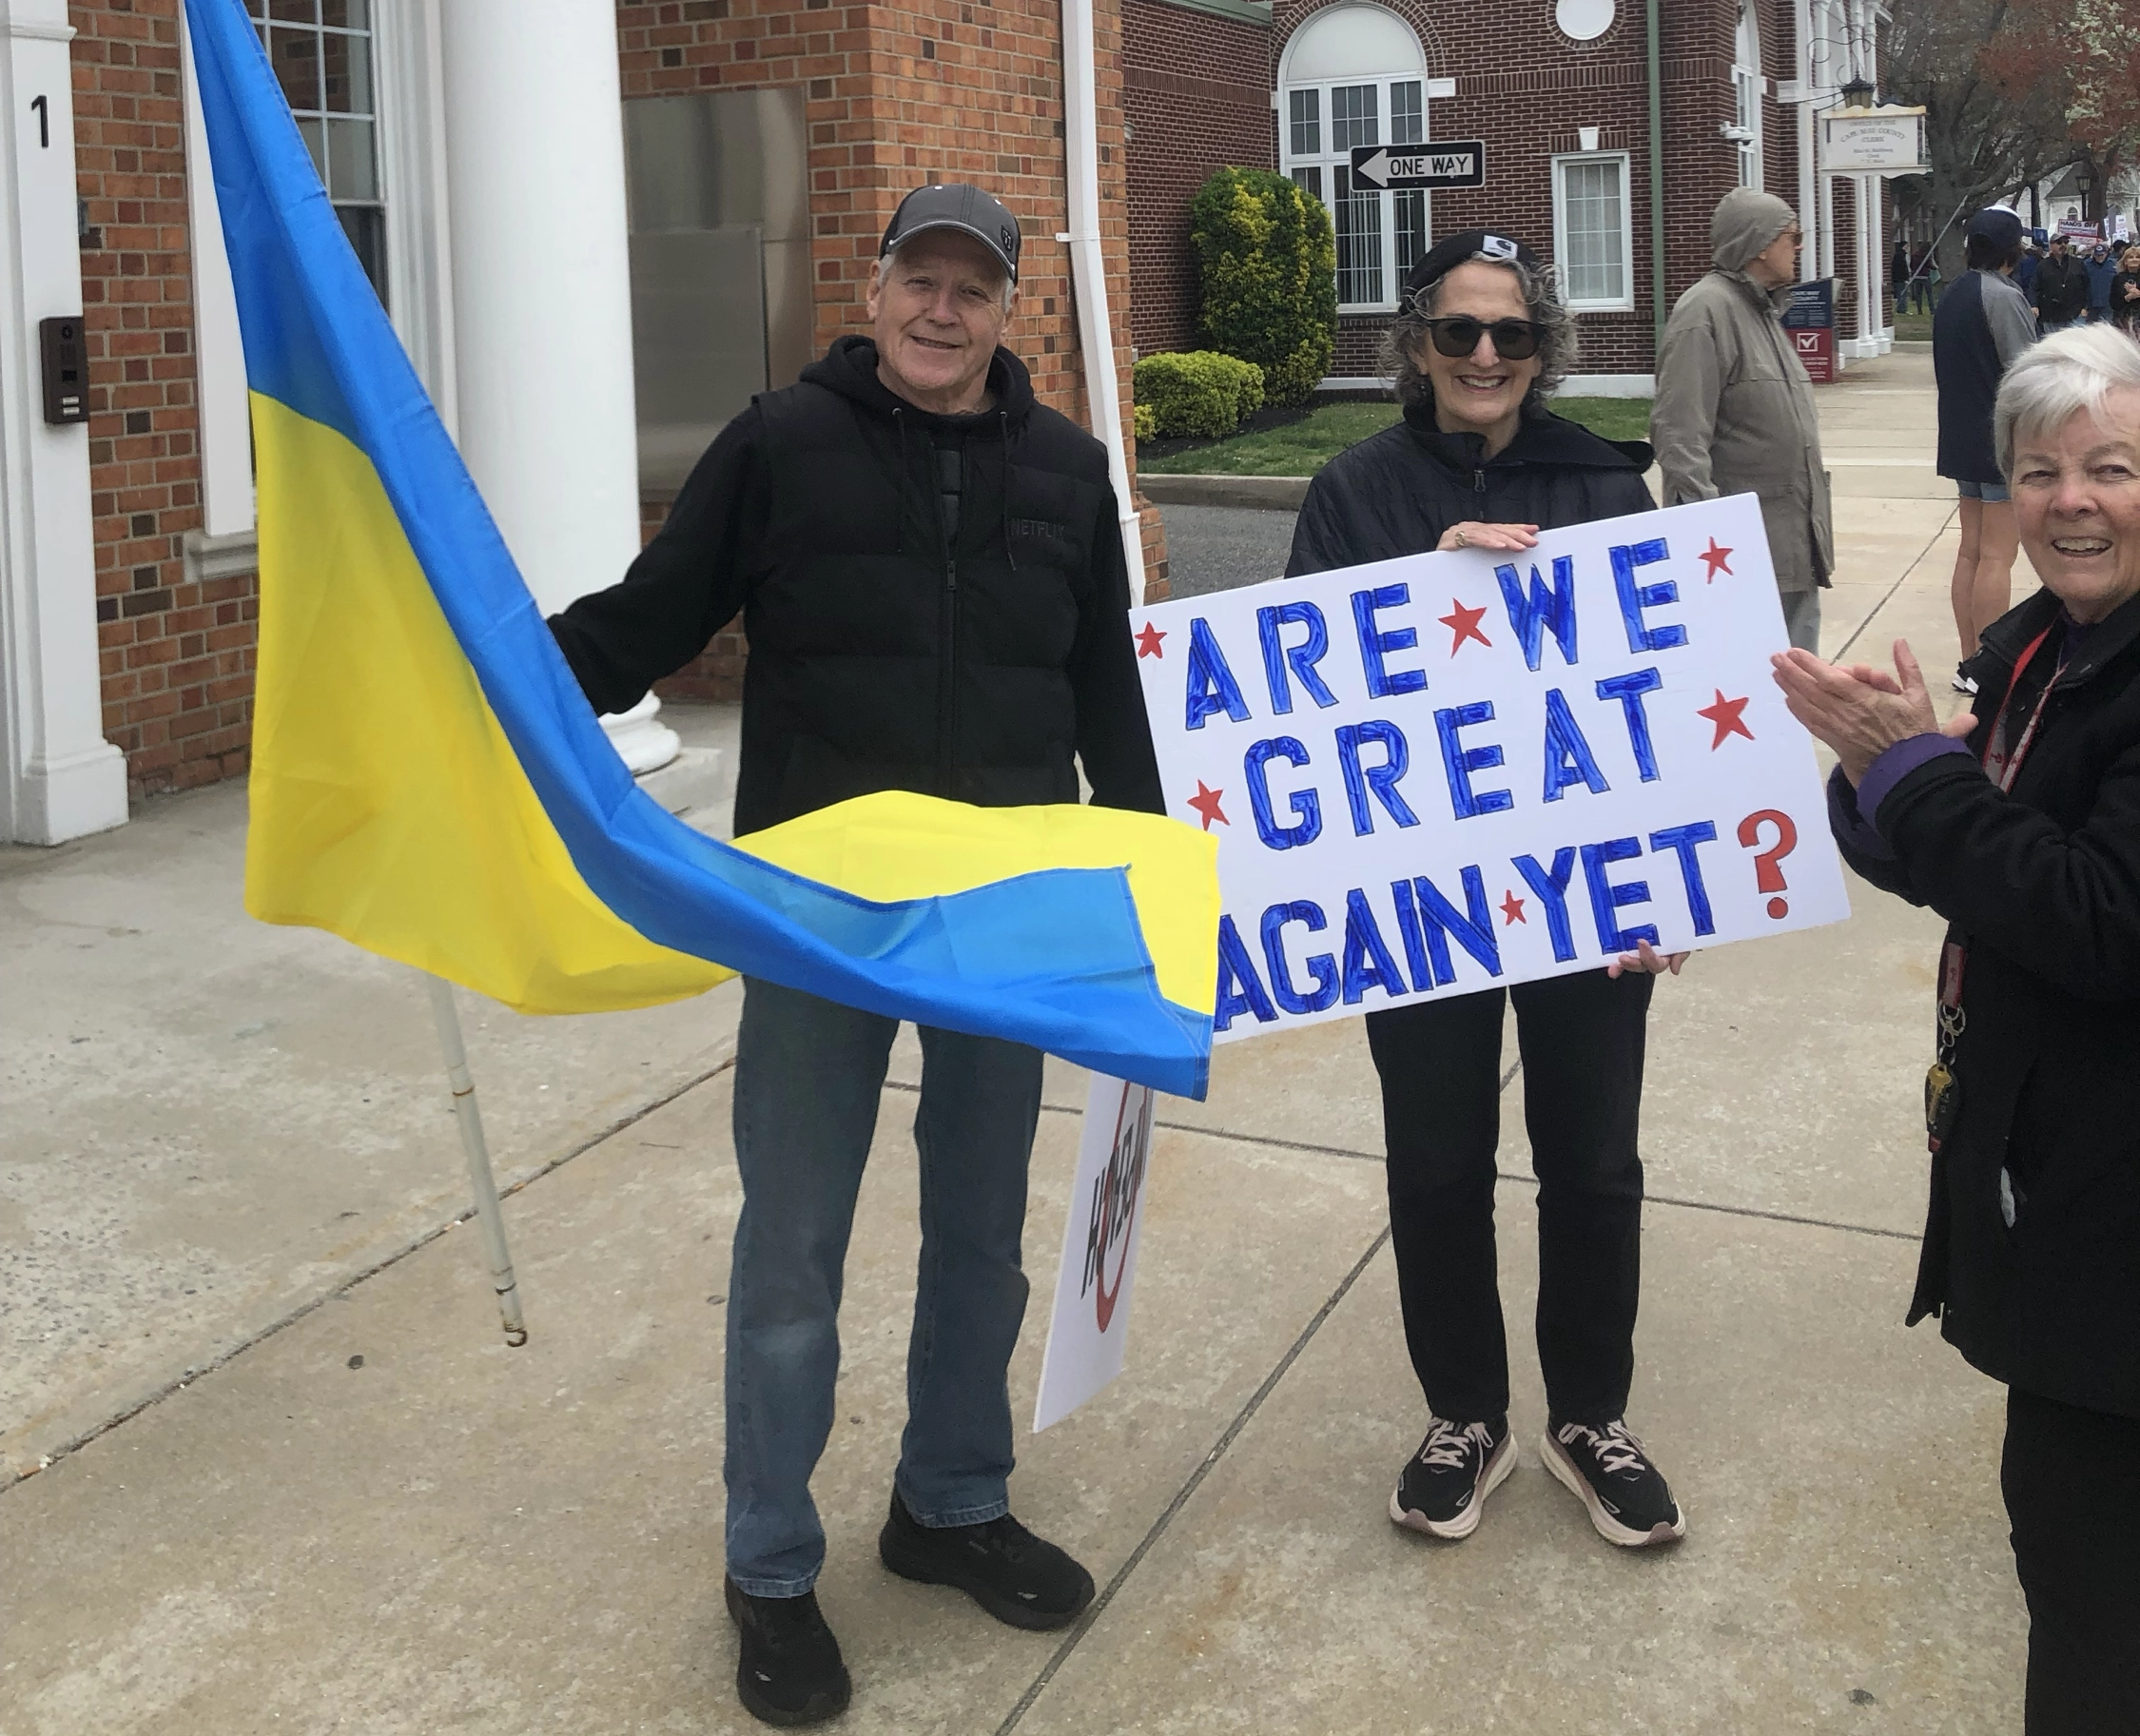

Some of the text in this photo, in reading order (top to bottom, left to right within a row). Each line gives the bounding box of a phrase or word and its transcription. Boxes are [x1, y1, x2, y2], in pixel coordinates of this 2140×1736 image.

[30, 93, 49, 148] 1
[1390, 156, 1469, 176] ONE WAY
[2060, 220, 2082, 228] HANDS
[1185, 537, 1690, 731] ARE WE
[1243, 667, 1663, 851] GREAT
[1213, 864, 1503, 1034] AGAIN
